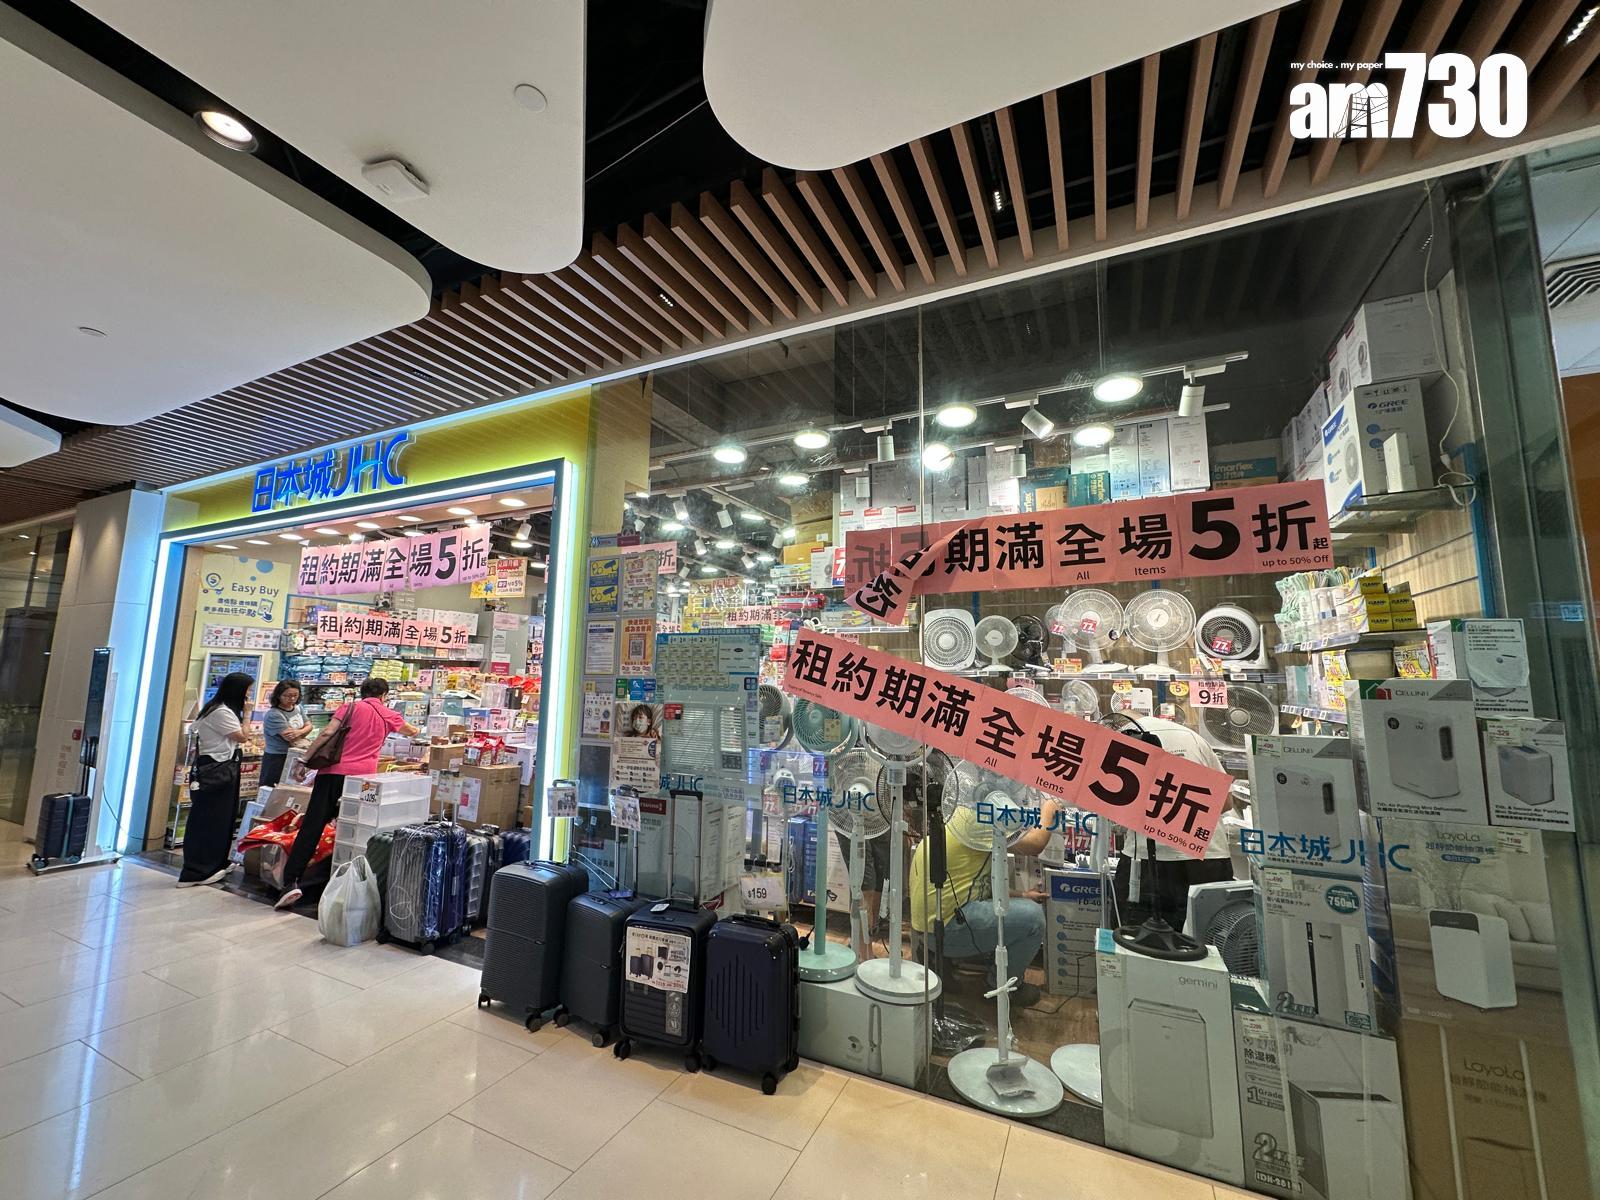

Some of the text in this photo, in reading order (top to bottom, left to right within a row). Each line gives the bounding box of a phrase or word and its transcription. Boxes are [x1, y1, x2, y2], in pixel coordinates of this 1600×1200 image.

[252, 432, 408, 513] 日本城 JHC
[1076, 566, 1167, 581] All Items
[1262, 555, 1330, 567] up to 50% Off
[231, 582, 280, 598] Easy Buy
[1198, 689, 1225, 705] 9折
[792, 638, 1212, 842] 租約期滿全場5折起
[984, 756, 1065, 795] All Items
[783, 784, 876, 812] 日本城 JHC
[976, 802, 1099, 836] 日本城 JHC
[1143, 823, 1204, 854] up to 50% Off
[1240, 828, 1412, 872] 日本城 JHC
[748, 887, 767, 899] $159
[1178, 974, 1219, 990] gemini
